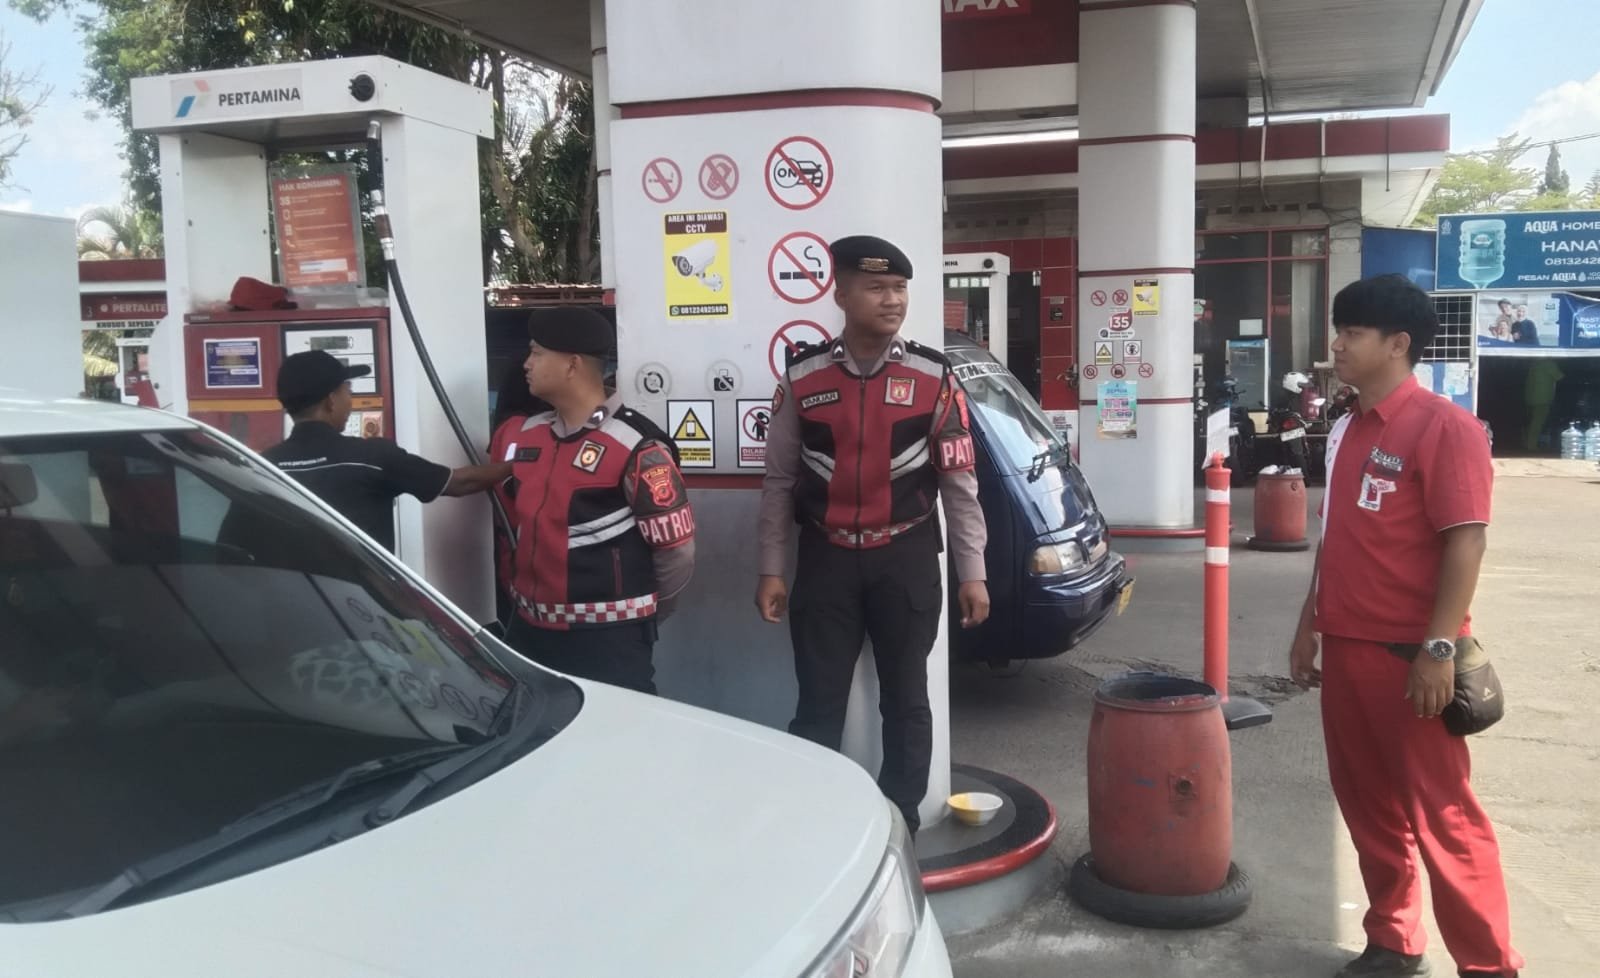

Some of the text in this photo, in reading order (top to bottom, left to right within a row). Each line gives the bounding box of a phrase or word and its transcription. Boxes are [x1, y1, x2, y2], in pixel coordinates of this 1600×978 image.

[943, 0, 1019, 13] AX
[218, 87, 301, 106] PERTAMINA
[777, 168, 797, 178] ON
[668, 212, 724, 223] AREA INI DIAWASI
[685, 223, 707, 234] CCTV
[1523, 221, 1600, 234] AQUA HOME
[1541, 239, 1600, 253] HANA
[1551, 272, 1577, 283] AQUA
[112, 303, 167, 313] PERTALITE
